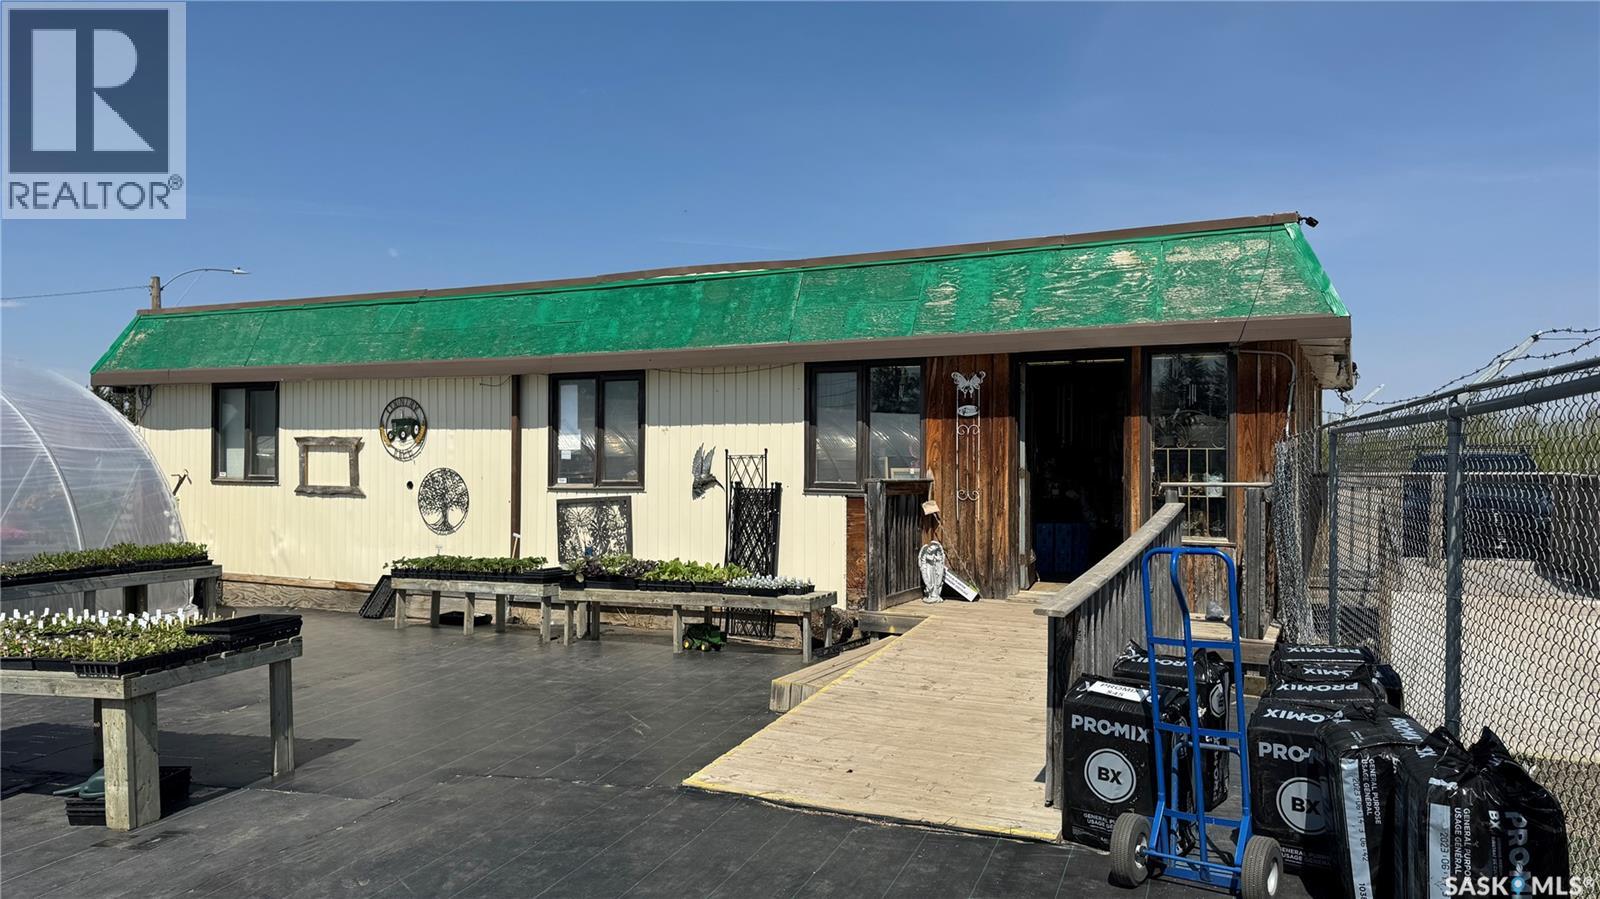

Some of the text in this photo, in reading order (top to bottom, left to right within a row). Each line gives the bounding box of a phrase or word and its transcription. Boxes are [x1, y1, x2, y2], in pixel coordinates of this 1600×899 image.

[1071, 714, 1150, 744] PRO-MIX
[1097, 766, 1122, 785] BX
[1291, 796, 1321, 816] BX
[1369, 758, 1382, 825] GENERAL PURPOSE
[1454, 807, 1462, 836] USAGE
[1488, 810, 1500, 829] BX
[1463, 807, 1471, 882] GENERAL PURPO
